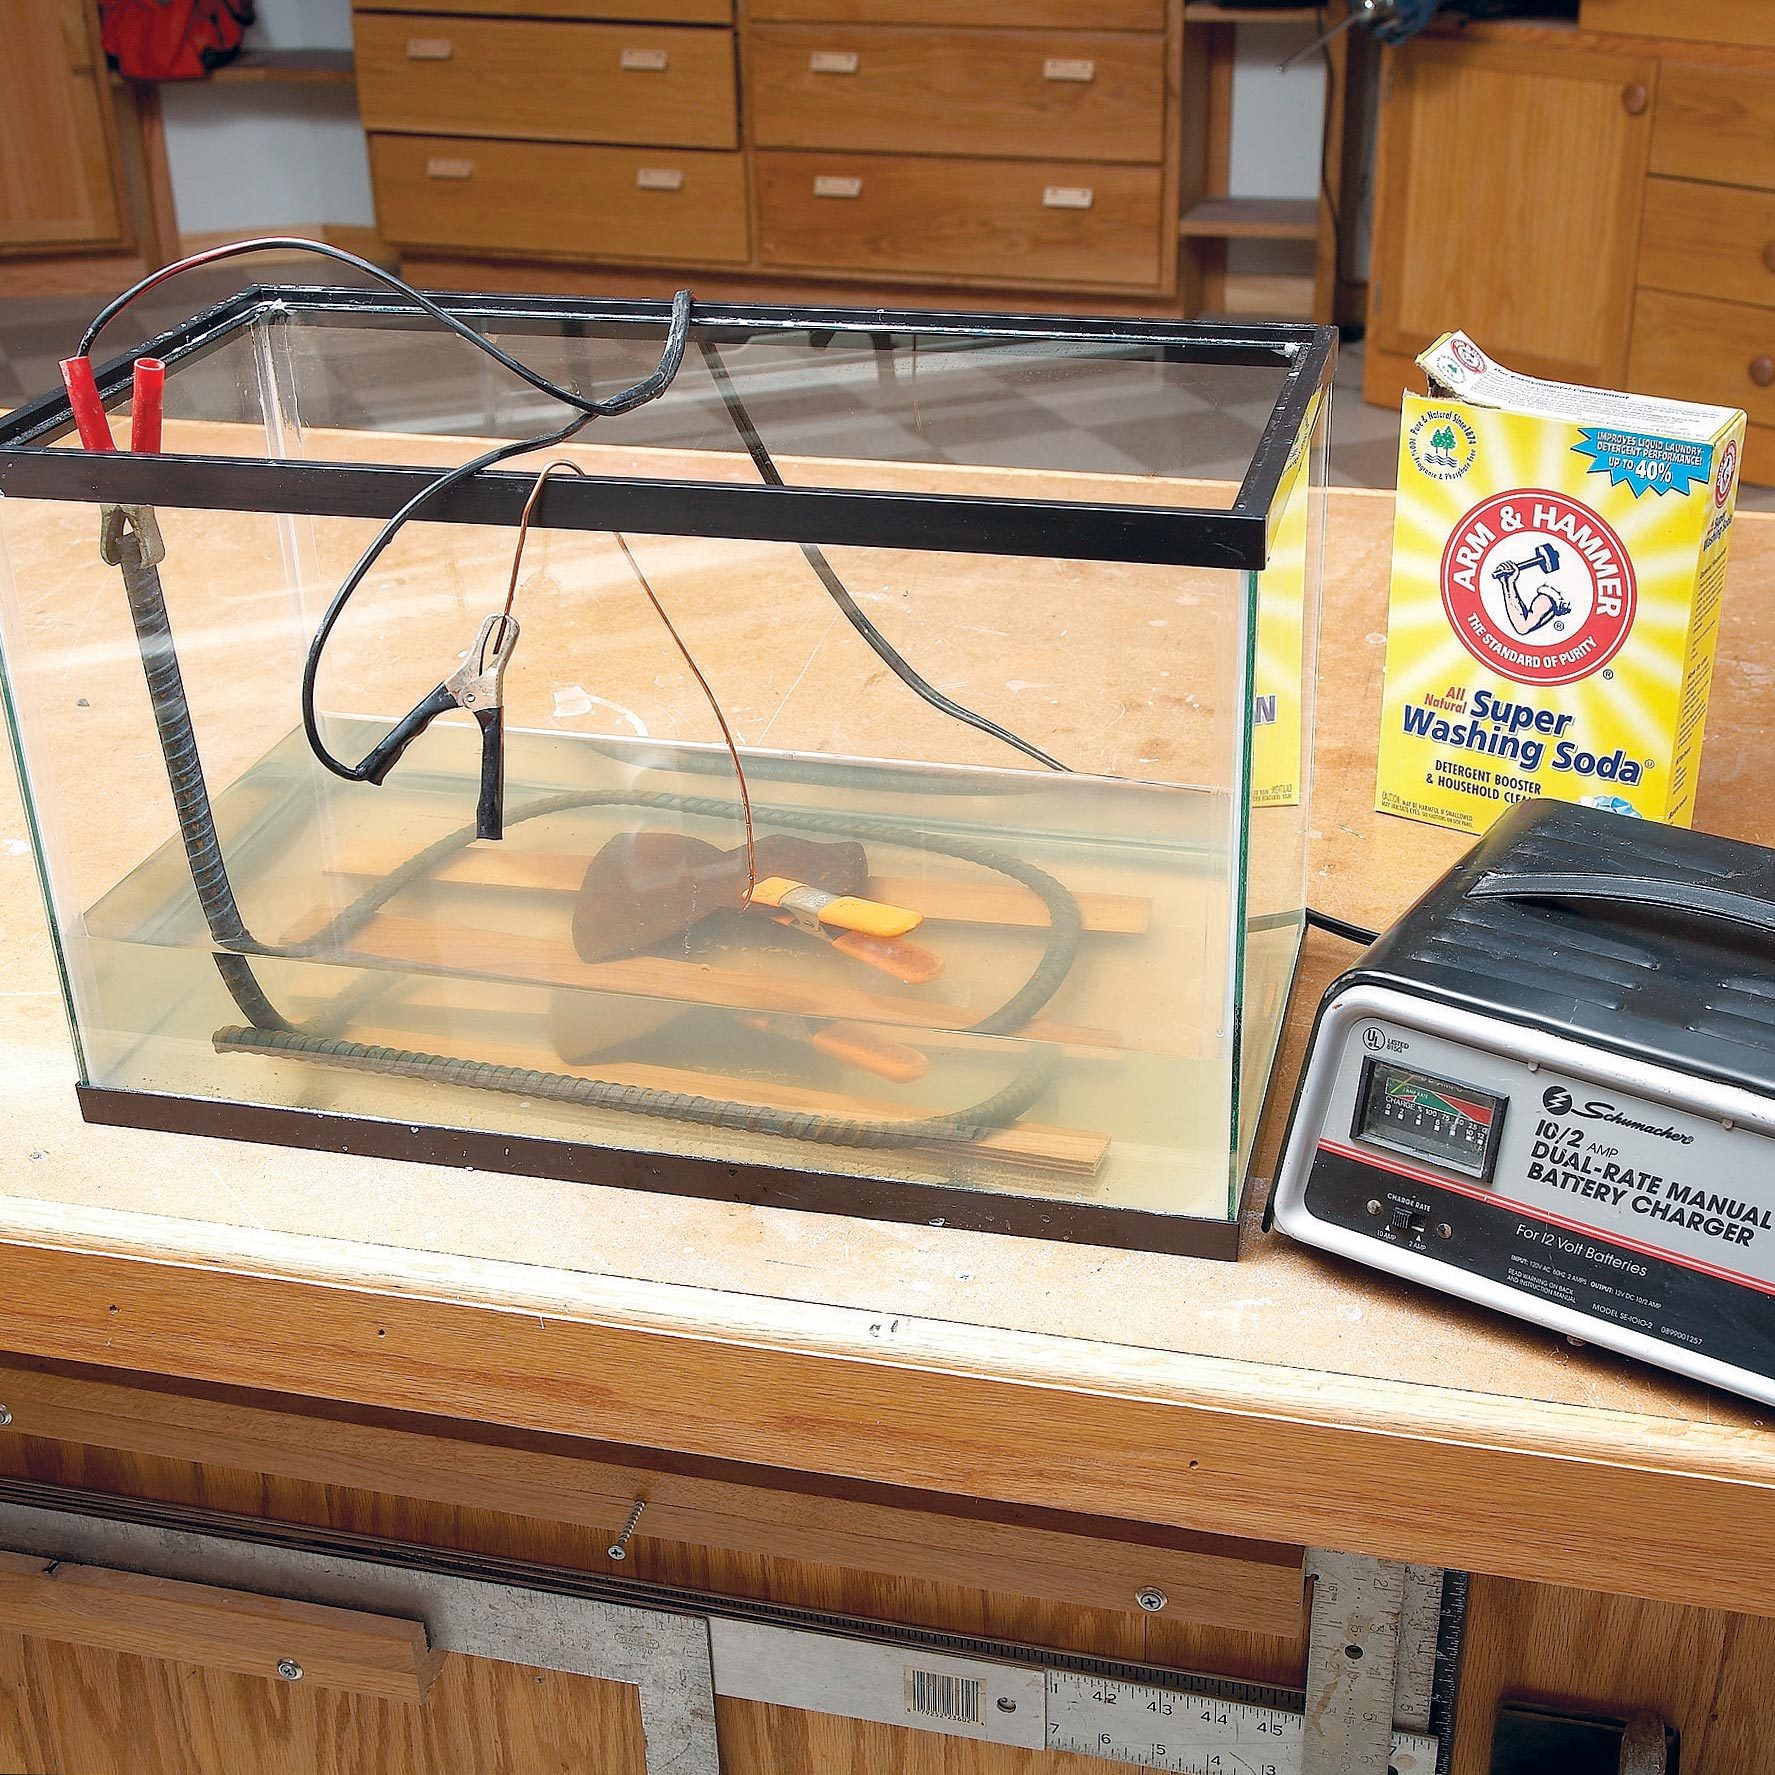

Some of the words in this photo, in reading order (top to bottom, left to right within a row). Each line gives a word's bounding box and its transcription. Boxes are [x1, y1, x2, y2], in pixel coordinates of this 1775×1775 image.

[1410, 416, 1424, 435] Pure
[1427, 411, 1452, 420] Natural
[1597, 442, 1640, 457] DETERGENT
[1598, 432, 1636, 445] IMPROVES
[1638, 438, 1663, 450] LIQUID
[1414, 457, 1437, 478] Fragrance
[1608, 457, 1619, 466] UP
[1622, 459, 1634, 470] TO
[1635, 460, 1672, 482] 40%
[1453, 521, 1496, 592] ARM
[1500, 505, 1524, 532] &
[1533, 504, 1622, 618] HAMMER
[1467, 612, 1484, 638] THE
[1482, 633, 1540, 668] STANDARD
[1543, 656, 1560, 668] OF
[1561, 636, 1597, 664] PURITY
[1424, 693, 1468, 714] Natural
[1446, 687, 1465, 700] All
[1470, 690, 1572, 734] Super
[1404, 705, 1544, 770] Washing
[1552, 742, 1642, 784] Soda
[1436, 760, 1491, 782] DETERGENT
[1495, 774, 1541, 794] BOOSTER
[1426, 774, 1434, 784] &
[1438, 776, 1499, 800] HOUSEHOLD
[1504, 792, 1536, 804] CLE
[1419, 804, 1439, 814] HARMFUL
[1367, 1030, 1380, 1048] UL
[1388, 1038, 1410, 1050] LISTED
[1386, 1096, 1416, 1111] CHARGE
[1426, 1109, 1437, 1117] 100
[1571, 1102, 1690, 1145] Schumacher
[1535, 1119, 1584, 1148] 10/2
[1586, 1142, 1618, 1158] AMP
[1531, 1141, 1664, 1194] DUAL-RATE
[1666, 1182, 1772, 1230] MANUAL
[1387, 1193, 1414, 1207] CHARGE
[1415, 1202, 1431, 1212] RATE
[1527, 1162, 1628, 1206] BATTERY
[1632, 1196, 1754, 1247] CHARGER
[1384, 1232, 1396, 1241] AMP
[1413, 1242, 1426, 1251] AMP
[1516, 1224, 1540, 1241] For
[1541, 1232, 1554, 1246] 12
[1557, 1237, 1584, 1256] Volt
[1585, 1247, 1648, 1277] Batteries
[1506, 1275, 1519, 1285] AND
[1520, 1278, 1554, 1296] INSTRUCTION
[1553, 1290, 1576, 1304] MANUAL
[1508, 1268, 1522, 1278] READ
[1522, 1272, 1548, 1287] WARNING
[1549, 1282, 1558, 1290] ON
[1558, 1285, 1574, 1295] BACK
[1510, 1254, 1528, 1266] INPUT:
[1530, 1260, 1543, 1270] 120V
[1543, 1264, 1551, 1273] AC
[1572, 1274, 1587, 1286] AMPS
[1590, 1282, 1614, 1295] OUTPUT:
[1615, 1288, 1625, 1298] 12V
[1625, 1292, 1635, 1301] DC
[1636, 1295, 1648, 1306] 10/2
[1648, 1300, 1662, 1310] AMP
[1592, 1304, 1618, 1318] MODEL
[1620, 1311, 1653, 1329] SE-1010-2
[1660, 1326, 1703, 1346] 0899001257
[1374, 1578, 1388, 1588] 2
[1092, 1690, 1117, 1705] 42
[1146, 1702, 1173, 1716] 43
[1200, 1711, 1228, 1725] 44
[1050, 1723, 1060, 1734] 7
[1101, 1733, 1111, 1744] 6
[1256, 1722, 1283, 1736] 45
[1156, 1744, 1166, 1755] 5
[1210, 1755, 1221, 1766] 4
[1266, 1765, 1276, 1775] 3
